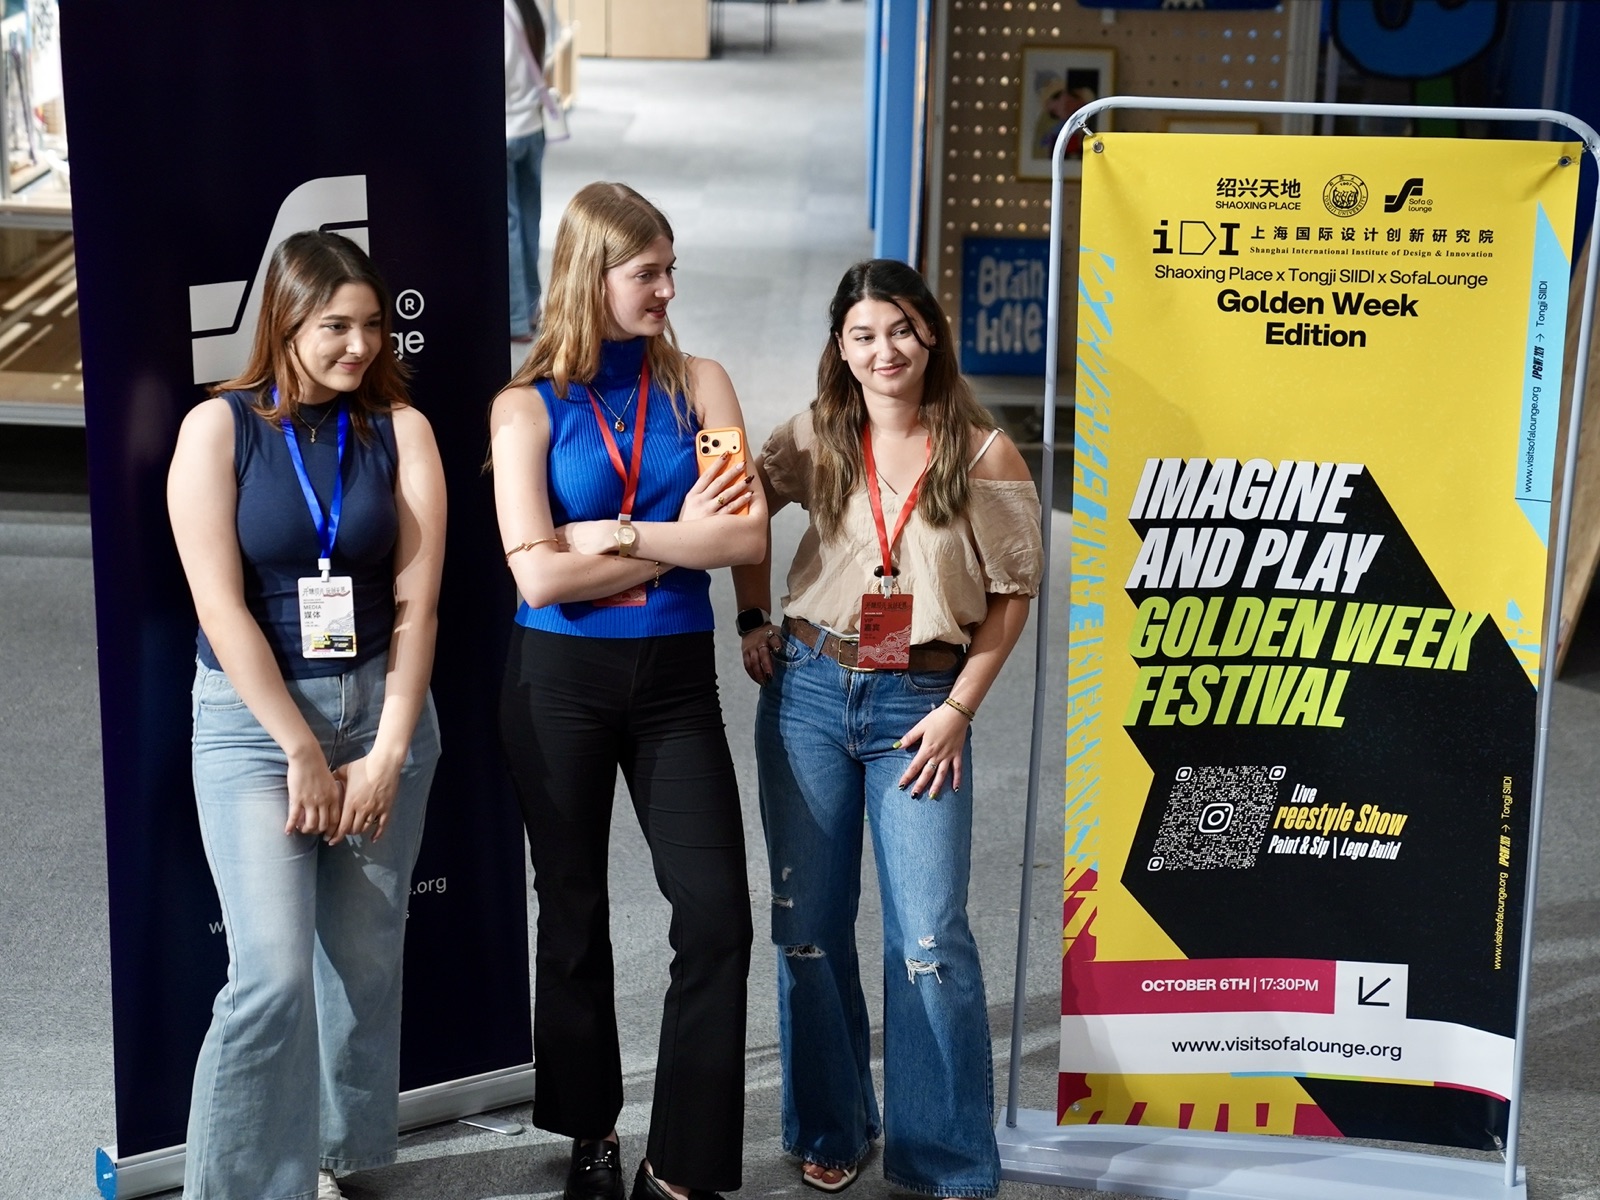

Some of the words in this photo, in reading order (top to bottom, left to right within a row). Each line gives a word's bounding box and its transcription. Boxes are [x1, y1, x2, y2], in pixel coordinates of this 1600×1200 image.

[1216, 177, 1301, 198] 绍兴天地
[1215, 200, 1267, 210] SHAOXING
[1268, 201, 1301, 211] PLACE
[1408, 205, 1433, 213] lounge
[1250, 225, 1494, 244] 上海国际设计创新研究院
[1250, 246, 1289, 255] Shanghai
[1292, 247, 1349, 255] International
[1352, 248, 1388, 256] Institute
[1391, 248, 1401, 256] of
[1403, 249, 1432, 258] Design
[1445, 250, 1493, 258] Innovation
[1155, 265, 1226, 283] Shaoxing
[1229, 266, 1273, 281] Place
[1276, 271, 1285, 281] x
[1289, 268, 1336, 286] Tongji
[1339, 269, 1375, 283] SIIDI
[1377, 273, 1386, 283] x
[1390, 270, 1488, 289] SofaLounge
[1217, 288, 1325, 314] Golden
[1332, 291, 1419, 317] Week
[1265, 321, 1367, 347] Edition
[1525, 386, 1542, 493] www.visitsofalounge.org
[1536, 301, 1548, 327] Tongji
[1128, 458, 1365, 523] IMAGINE
[1124, 527, 1245, 589] AND
[1241, 530, 1385, 594] PLAY
[1130, 596, 1336, 659] GOLDEN
[1332, 603, 1487, 671] WEEK
[1123, 665, 1350, 729] FESTIVAL
[1290, 783, 1318, 804] Live
[1273, 802, 1355, 836] reestyle
[1354, 803, 1408, 836] Show
[1501, 795, 1513, 819] Tongji
[1267, 834, 1301, 855] Paint
[1299, 835, 1311, 855] &
[1309, 835, 1331, 859] Sip
[1340, 837, 1369, 860] Lego
[1367, 839, 1402, 860] Build
[1494, 871, 1509, 970] www.visitsofalounge.org
[1141, 978, 1217, 992] OCTOBER
[1219, 977, 1250, 991] 6TH
[1259, 977, 1319, 992] 17:30PM
[1171, 1036, 1403, 1062] www.visitsofalounge.org
